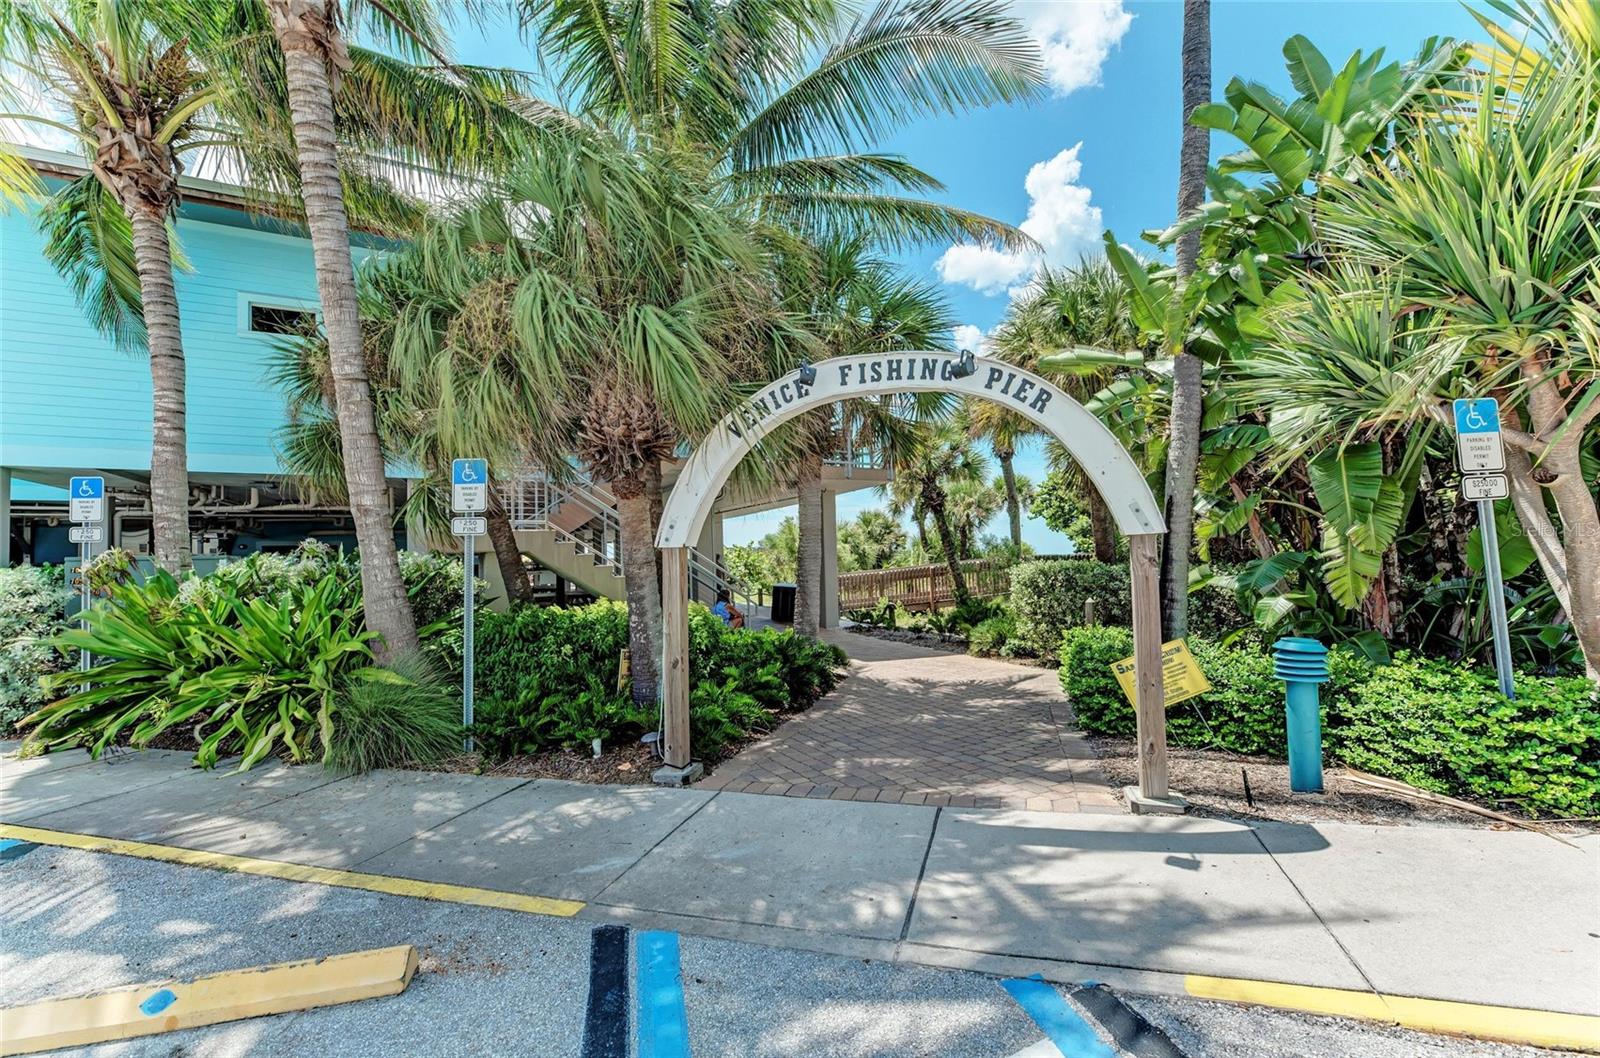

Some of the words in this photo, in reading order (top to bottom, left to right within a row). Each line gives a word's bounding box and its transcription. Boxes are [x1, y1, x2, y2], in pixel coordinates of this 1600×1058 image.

[728, 378, 810, 438] VENICE
[838, 358, 953, 387] FISHING
[984, 367, 1053, 414] PIER
[1479, 488, 1493, 496] FINE
